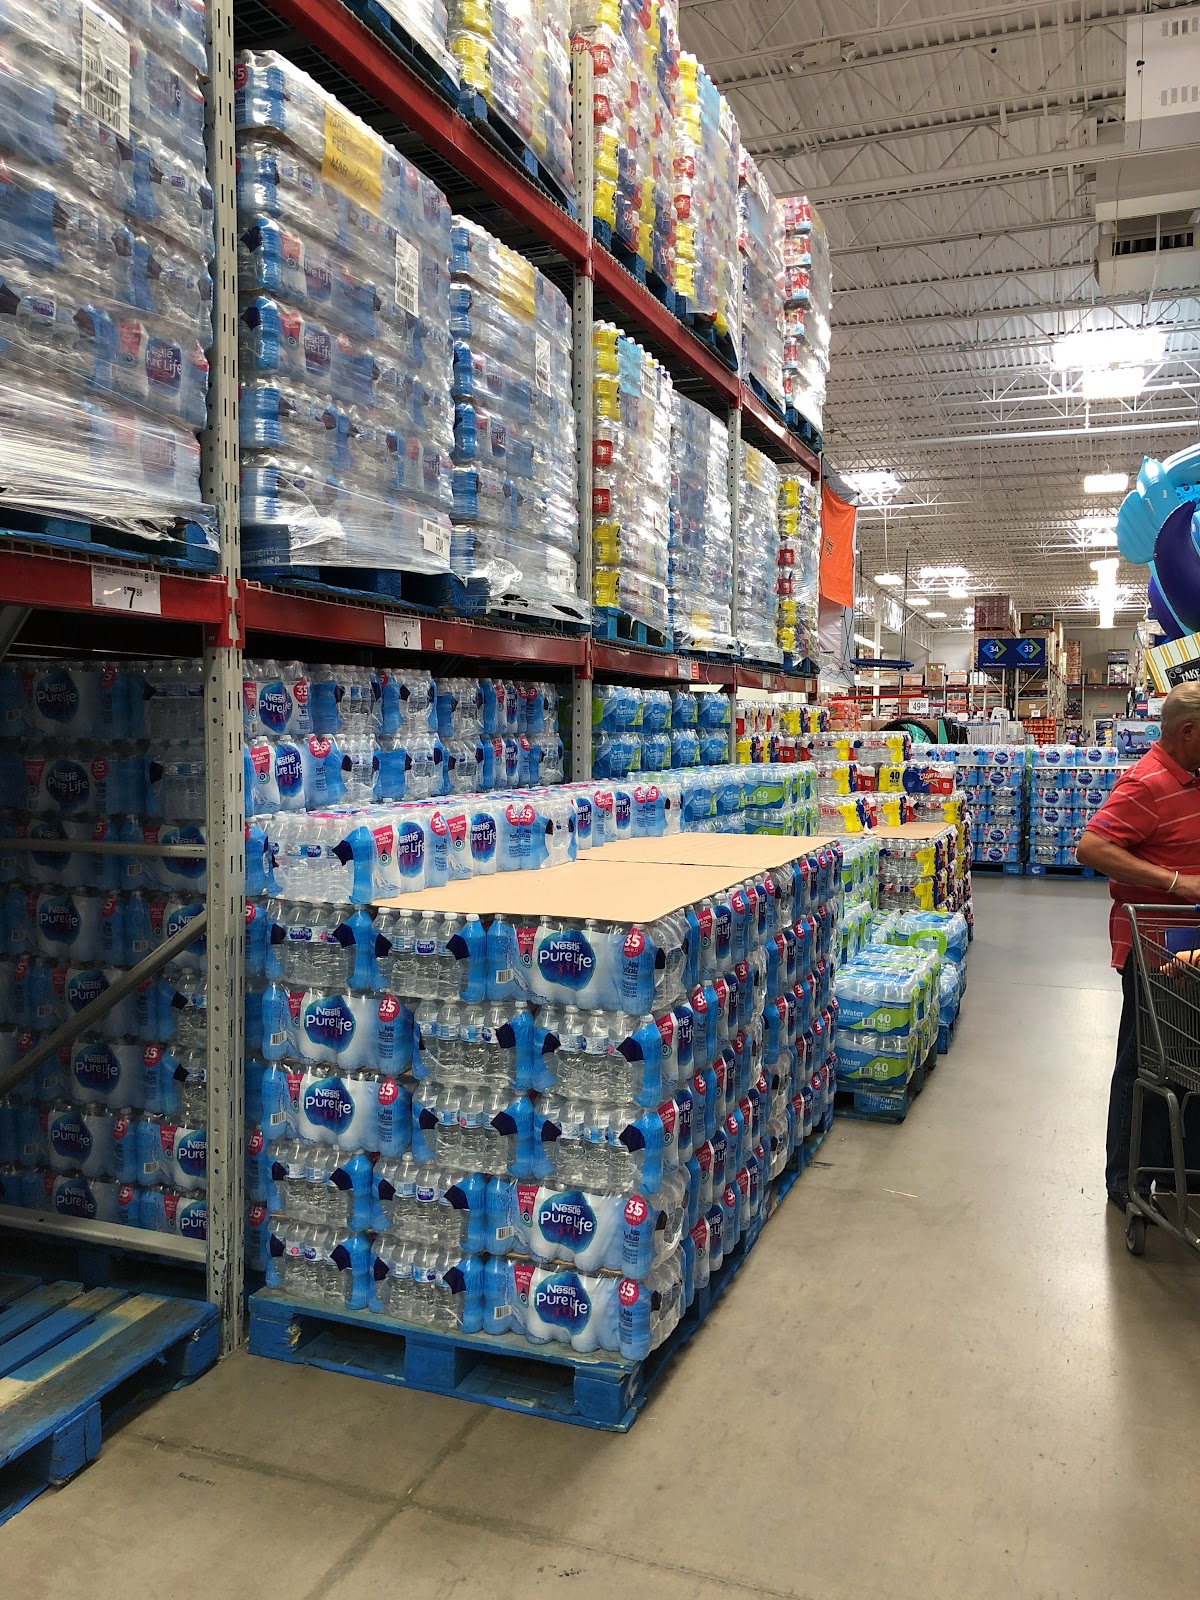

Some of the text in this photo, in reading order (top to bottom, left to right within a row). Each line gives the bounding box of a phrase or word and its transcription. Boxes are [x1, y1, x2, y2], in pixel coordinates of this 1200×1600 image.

[332, 136, 346, 155] FEB
[330, 156, 349, 177] MAR
[164, 358, 182, 377] Life
[1024, 645, 1034, 653] 33
[104, 671, 113, 680] 5
[37, 692, 62, 703] Pure
[260, 700, 283, 713] Pure
[277, 753, 296, 767] estlé
[93, 761, 104, 772] 35
[276, 764, 303, 778] ure Life
[889, 771, 900, 779] 40
[69, 780, 88, 794] Life
[756, 790, 768, 799] 40
[471, 822, 490, 832] estlé
[399, 832, 419, 843] estlé
[471, 829, 497, 844] ure Life
[398, 841, 425, 857] ure Life
[766, 880, 774, 889] 3
[733, 897, 743, 907] 3
[245, 905, 253, 917] 5
[40, 914, 66, 925] Pure
[624, 934, 641, 947] 35
[540, 950, 573, 964] Pure
[16, 962, 25, 973] 5
[69, 989, 95, 1000] Pure
[694, 993, 706, 1006] 3
[380, 999, 396, 1013] 35
[843, 1009, 864, 1017] Water
[876, 1013, 892, 1023] 40
[306, 1015, 336, 1027] Pure
[144, 1047, 156, 1058] 35
[76, 1062, 101, 1073] Pure
[840, 1058, 861, 1066] Water
[873, 1062, 889, 1072] 40
[696, 1076, 705, 1087] 3
[379, 1081, 394, 1096] 35
[305, 1096, 335, 1109] Pure
[728, 1116, 738, 1129] 3
[52, 1129, 76, 1141] Pure
[179, 1148, 205, 1159] Pure
[726, 1188, 735, 1200] 3
[57, 1195, 81, 1206] Pure
[626, 1200, 644, 1216] 35
[181, 1218, 206, 1229] Pure
[540, 1211, 573, 1225] Pure
[620, 1281, 635, 1296] 35
[536, 1292, 568, 1306] Pure
